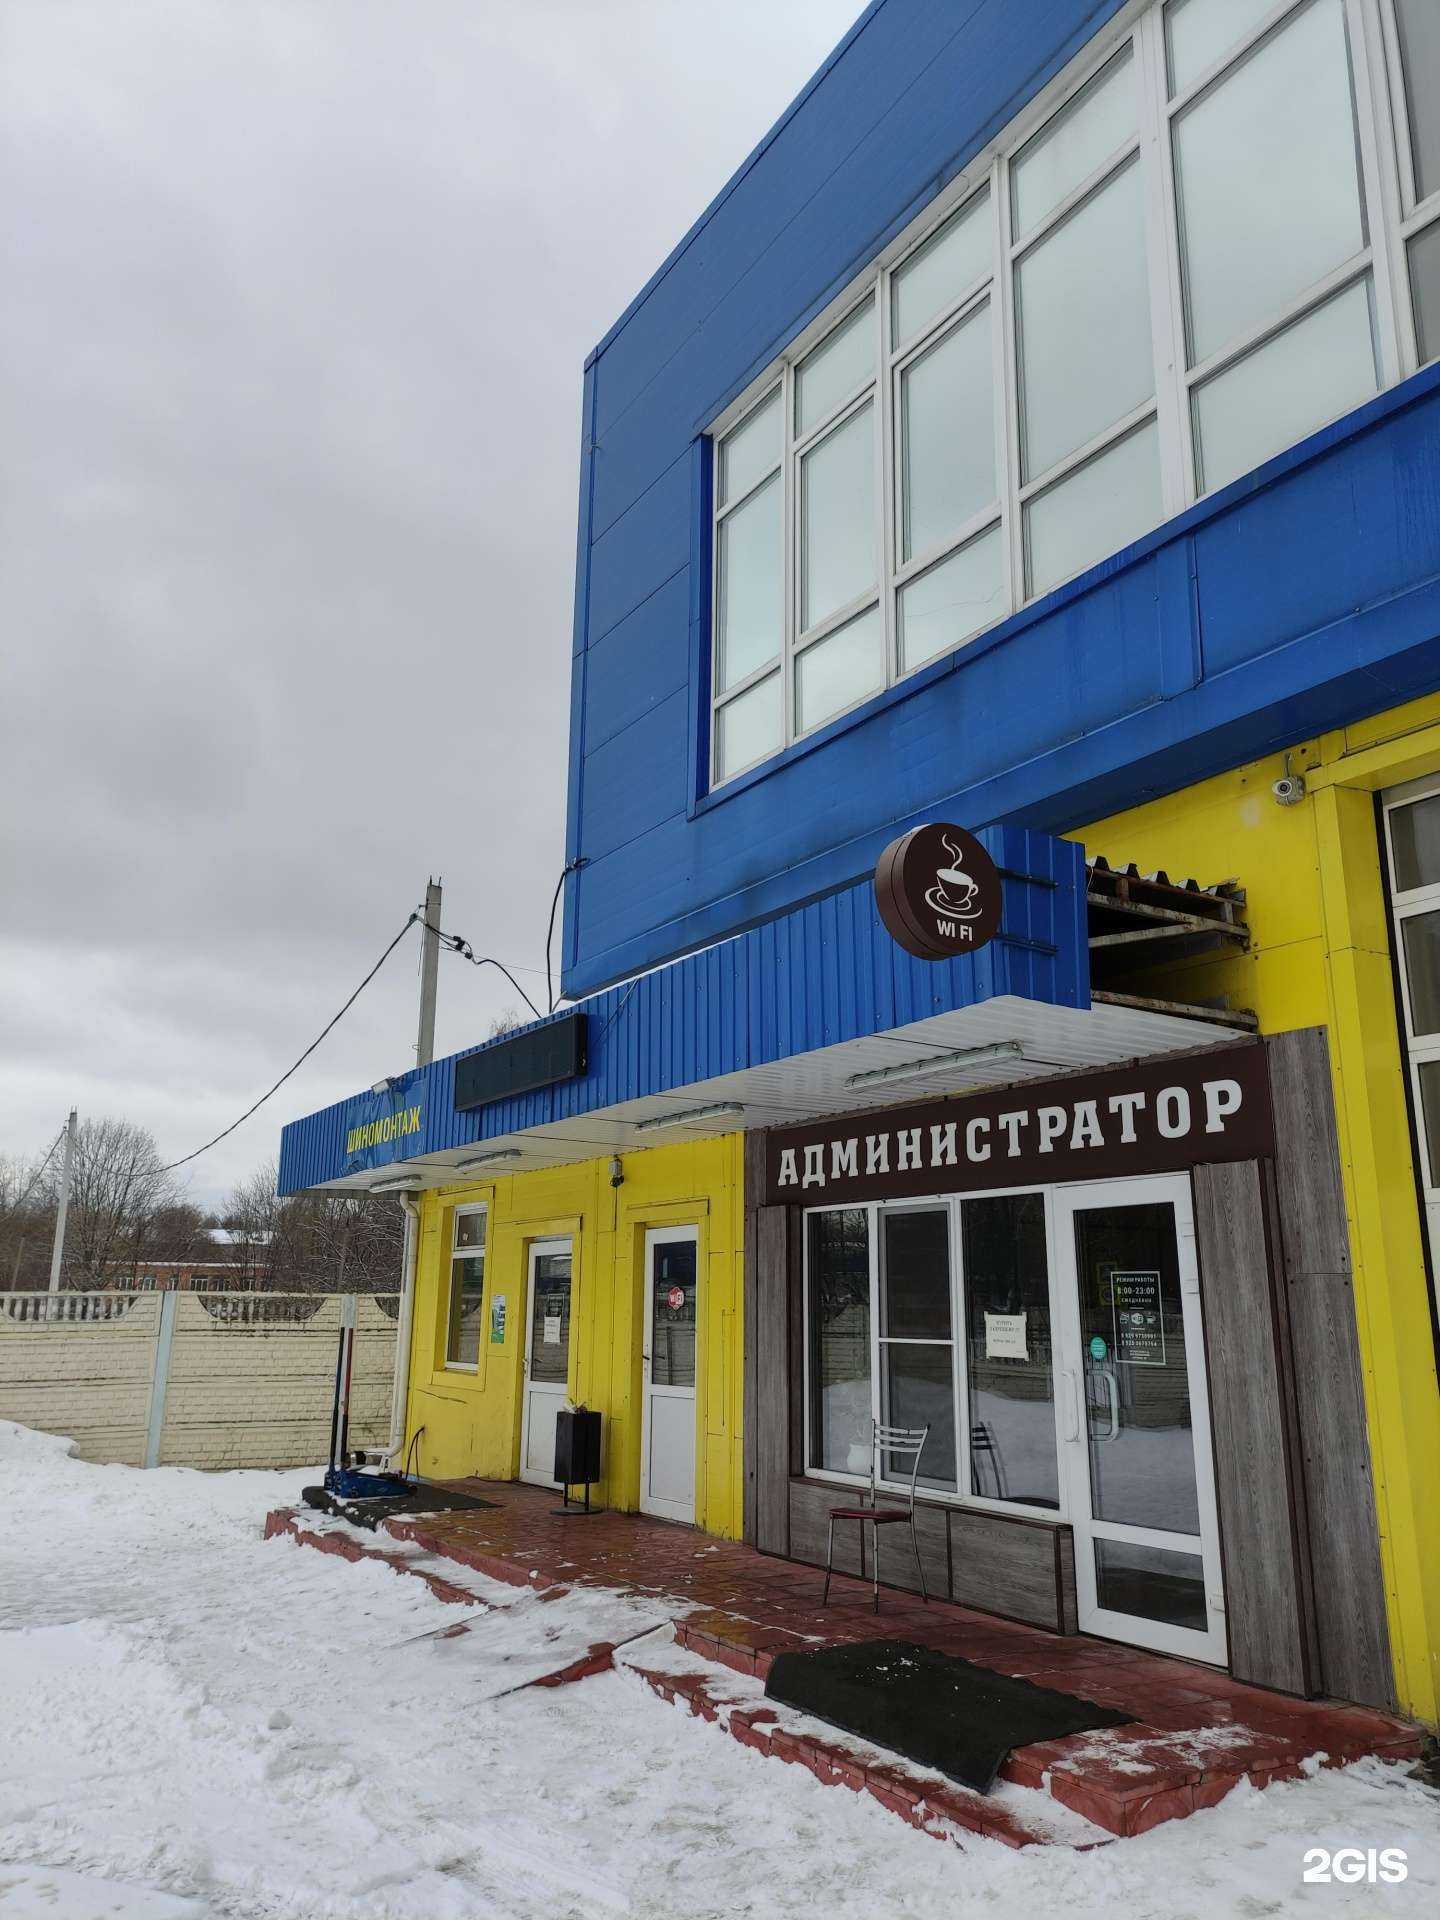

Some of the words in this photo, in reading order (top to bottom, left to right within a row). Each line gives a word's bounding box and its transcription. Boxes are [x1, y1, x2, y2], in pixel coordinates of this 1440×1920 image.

[936, 919, 956, 938] WI
[960, 925, 974, 942] FI
[346, 1105, 422, 1154] ШИНОМОНТАЖ
[777, 1079, 1244, 1190] АДМИНИСТРАТОР
